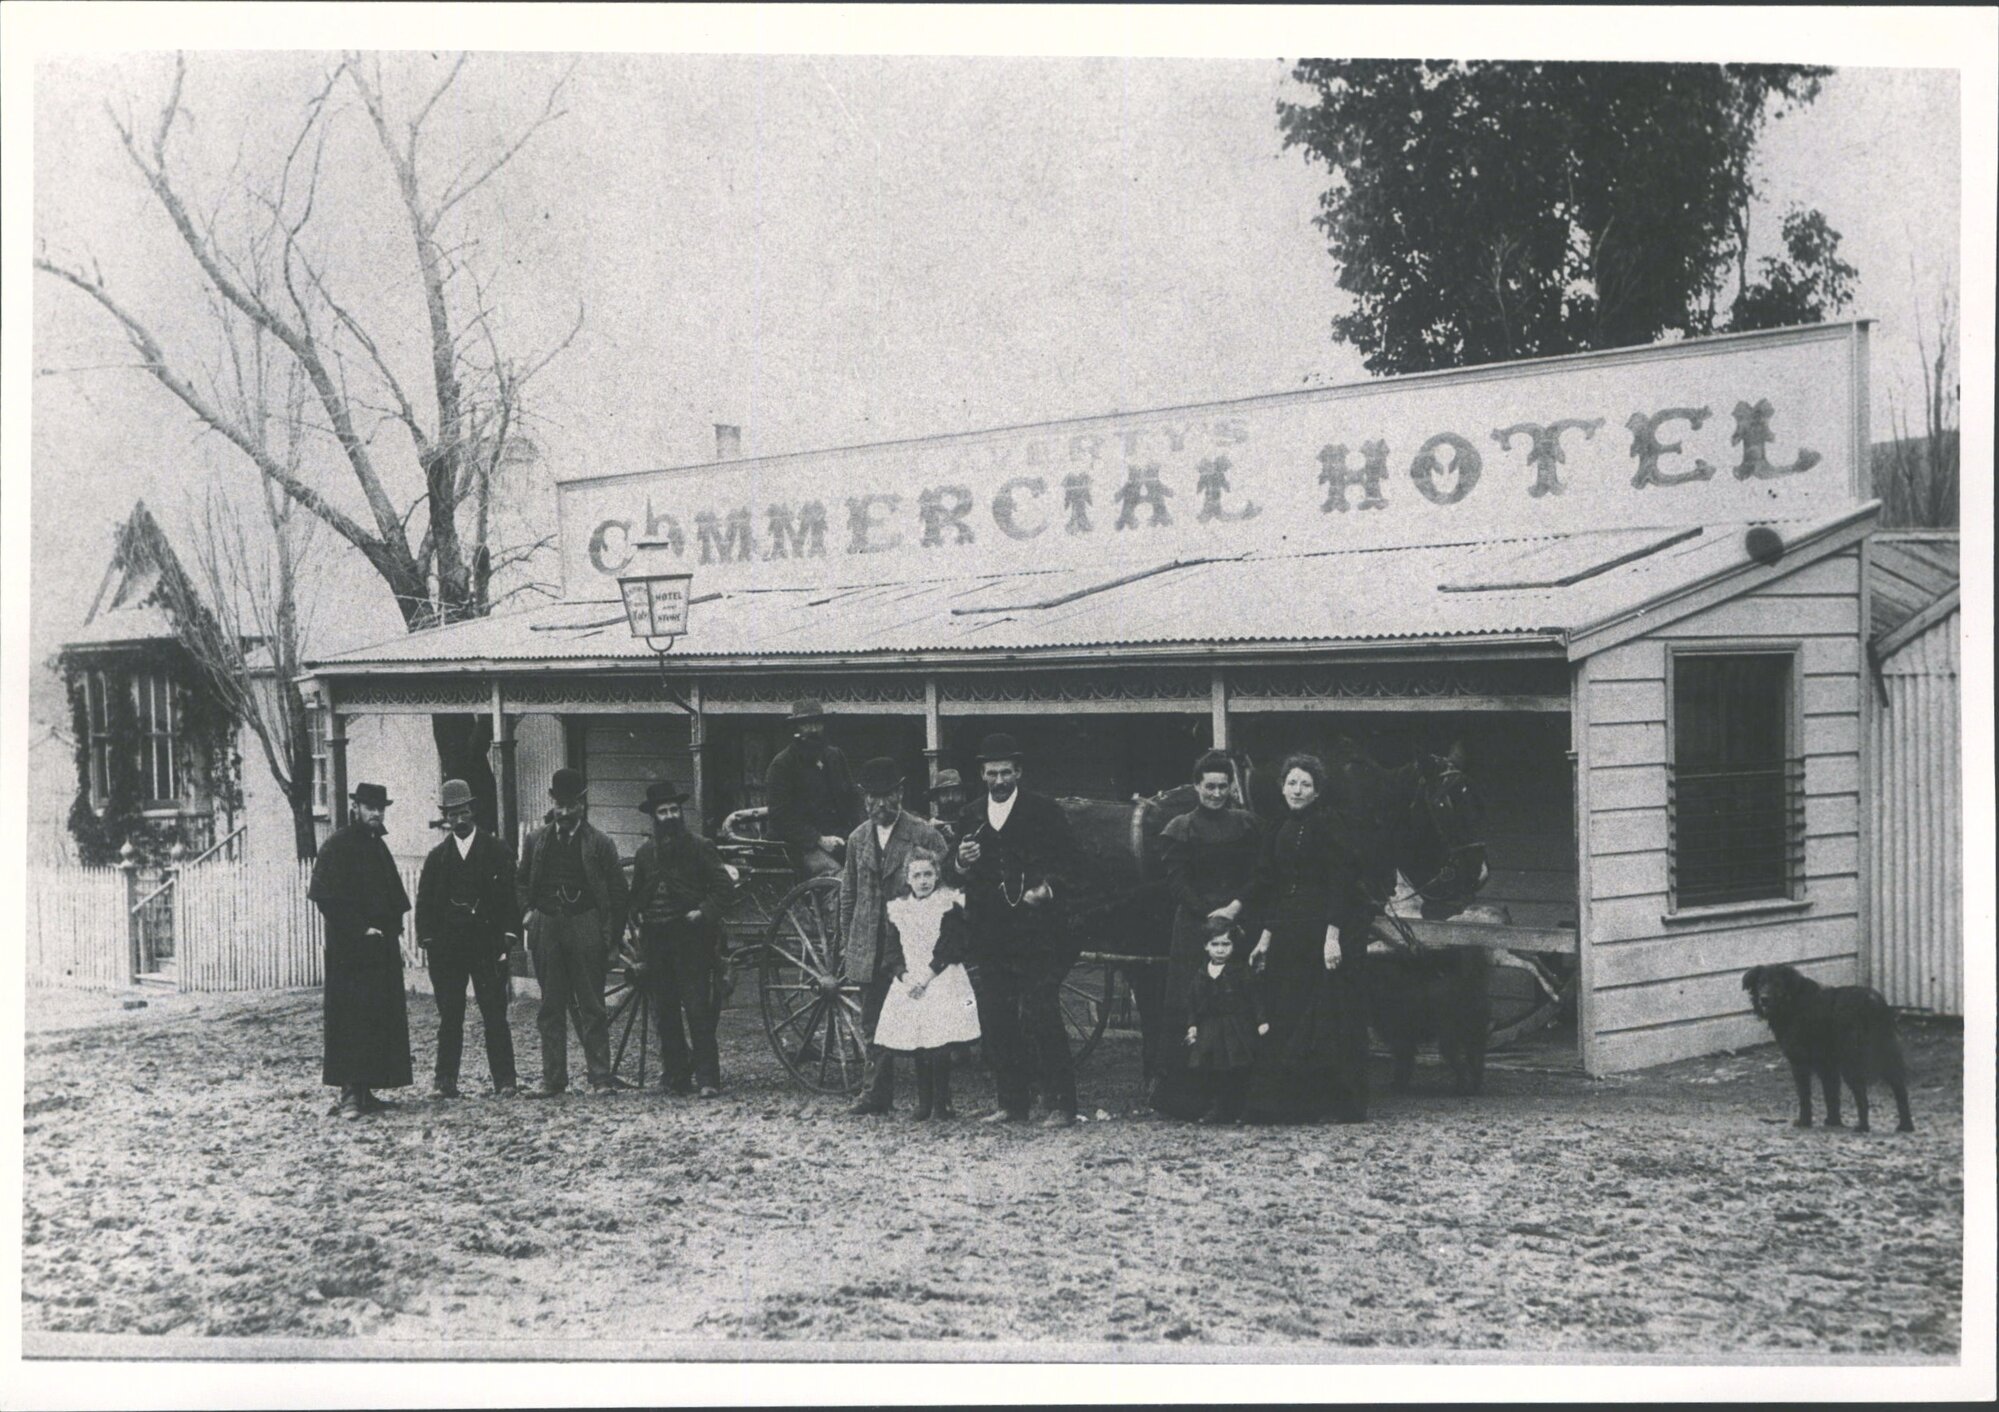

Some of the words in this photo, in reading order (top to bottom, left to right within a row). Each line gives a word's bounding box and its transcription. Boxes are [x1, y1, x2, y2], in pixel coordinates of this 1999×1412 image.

[1316, 398, 1821, 513] HOTEL
[655, 591, 683, 601] HOTEL
[657, 613, 681, 622] STORE
